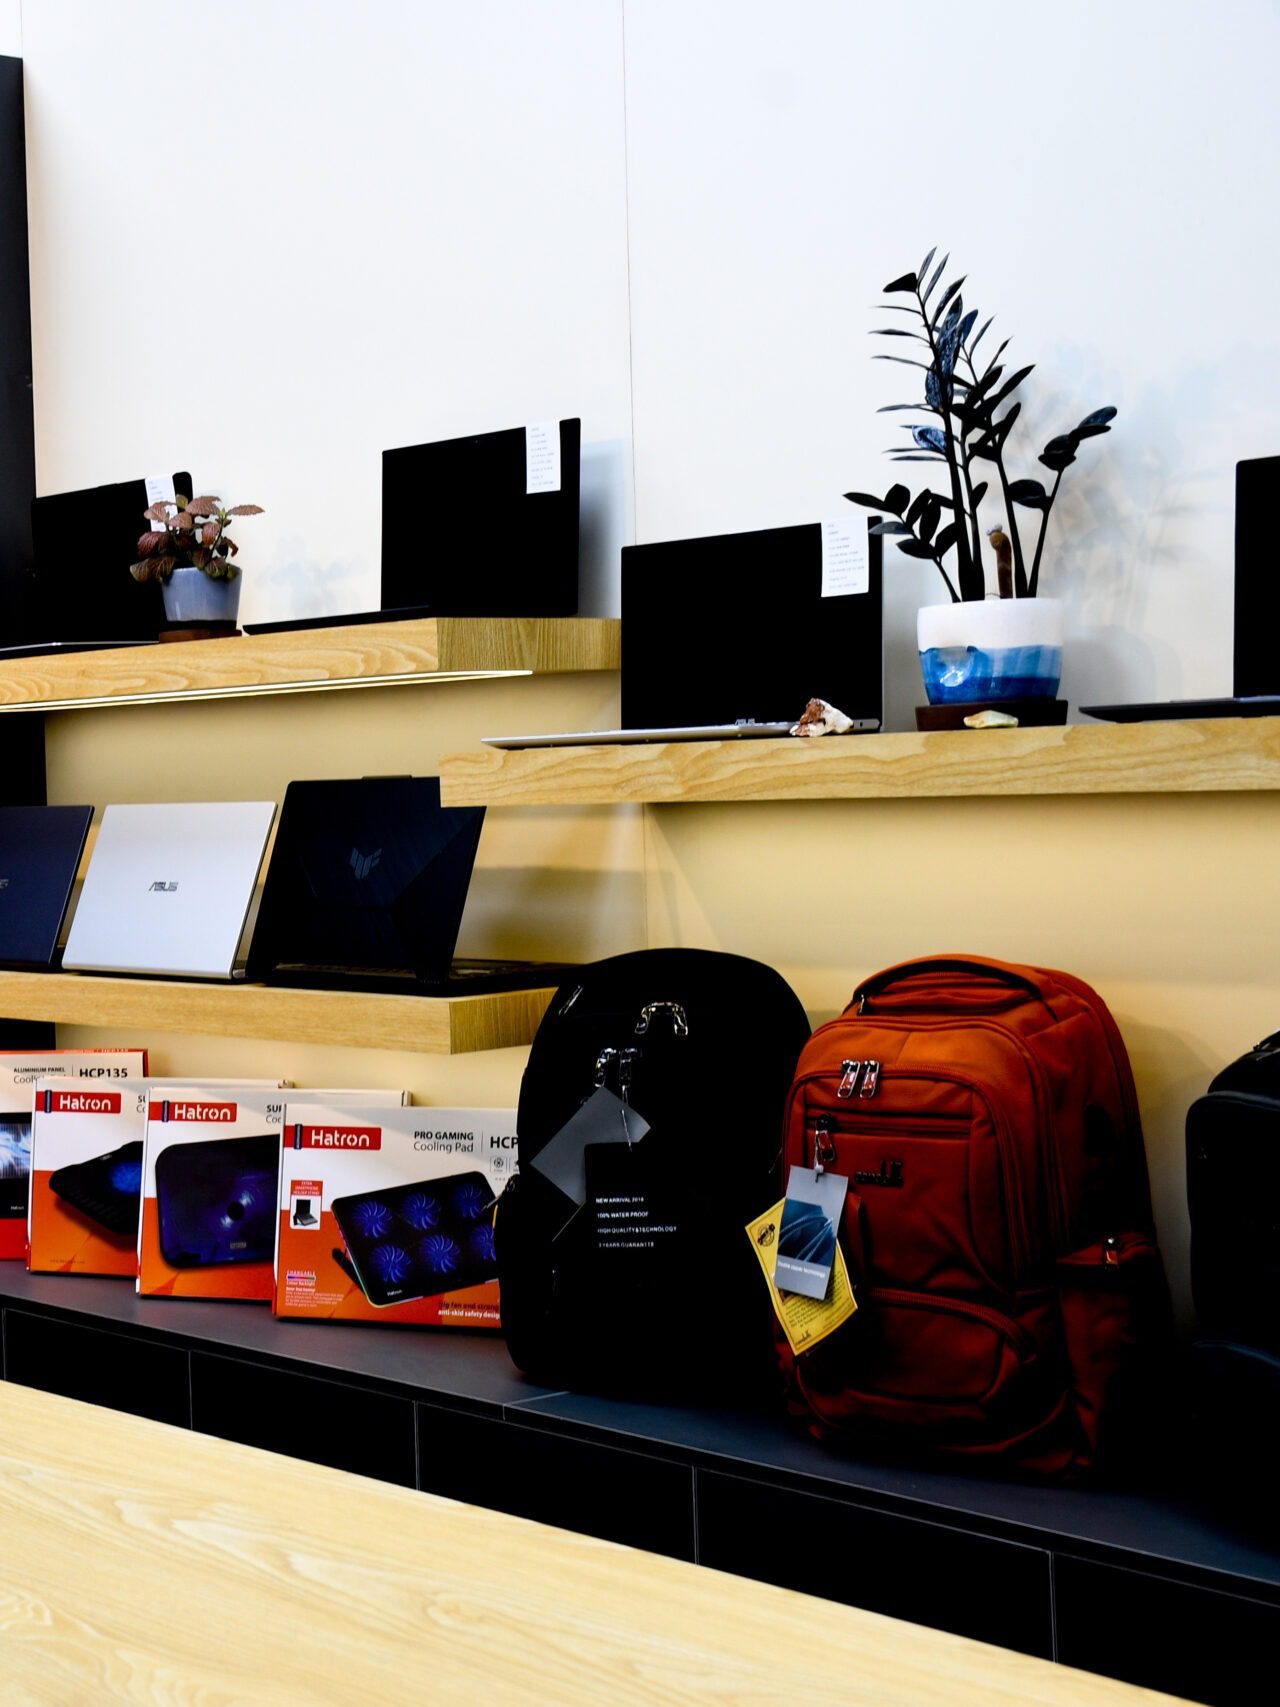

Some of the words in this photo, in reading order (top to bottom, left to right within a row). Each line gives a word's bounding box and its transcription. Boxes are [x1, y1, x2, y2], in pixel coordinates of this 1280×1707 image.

[148, 881, 179, 891] ASUS
[79, 1068, 128, 1078] HCP135
[60, 1094, 111, 1111] Hatron
[174, 1104, 231, 1120] Hatron
[311, 1129, 370, 1147] Hatron
[414, 1131, 438, 1140] PRO
[440, 1132, 474, 1141] GAMING
[413, 1141, 453, 1154] Cooling
[455, 1142, 474, 1152] Pad
[477, 1303, 499, 1311] strong
[438, 1309, 464, 1317] anti-skid
[465, 1310, 483, 1319] safety
[483, 1311, 500, 1320] desig
